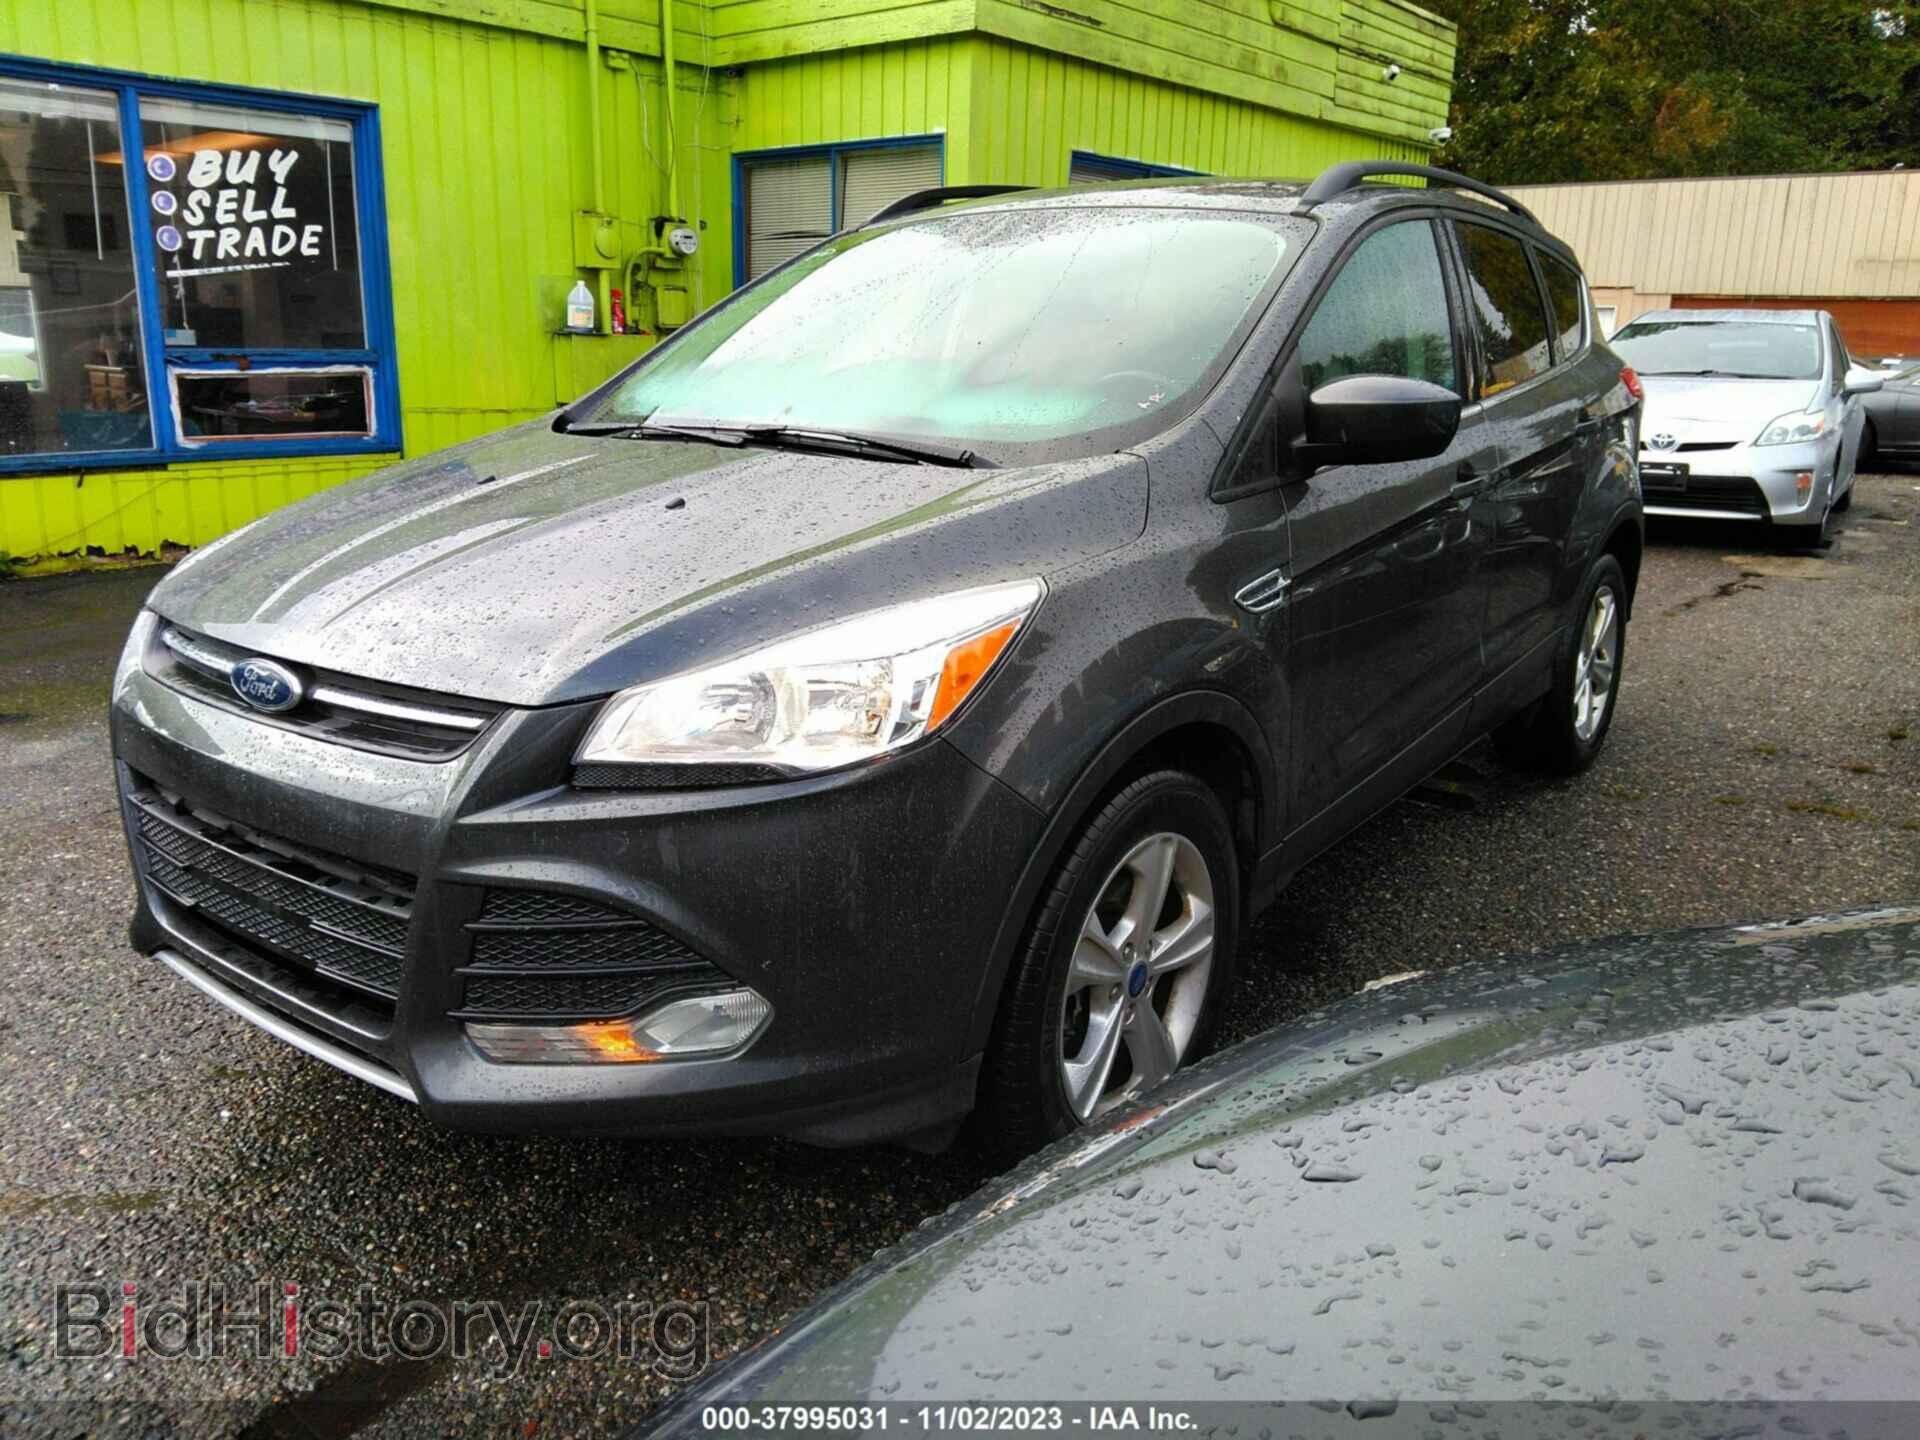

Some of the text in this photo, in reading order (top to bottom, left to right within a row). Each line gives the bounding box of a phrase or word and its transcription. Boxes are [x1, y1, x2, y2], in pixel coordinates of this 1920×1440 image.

[187, 149, 298, 188] BUY
[183, 186, 296, 226] SELL
[187, 225, 323, 260] TRADE
[240, 665, 279, 700] Ford
